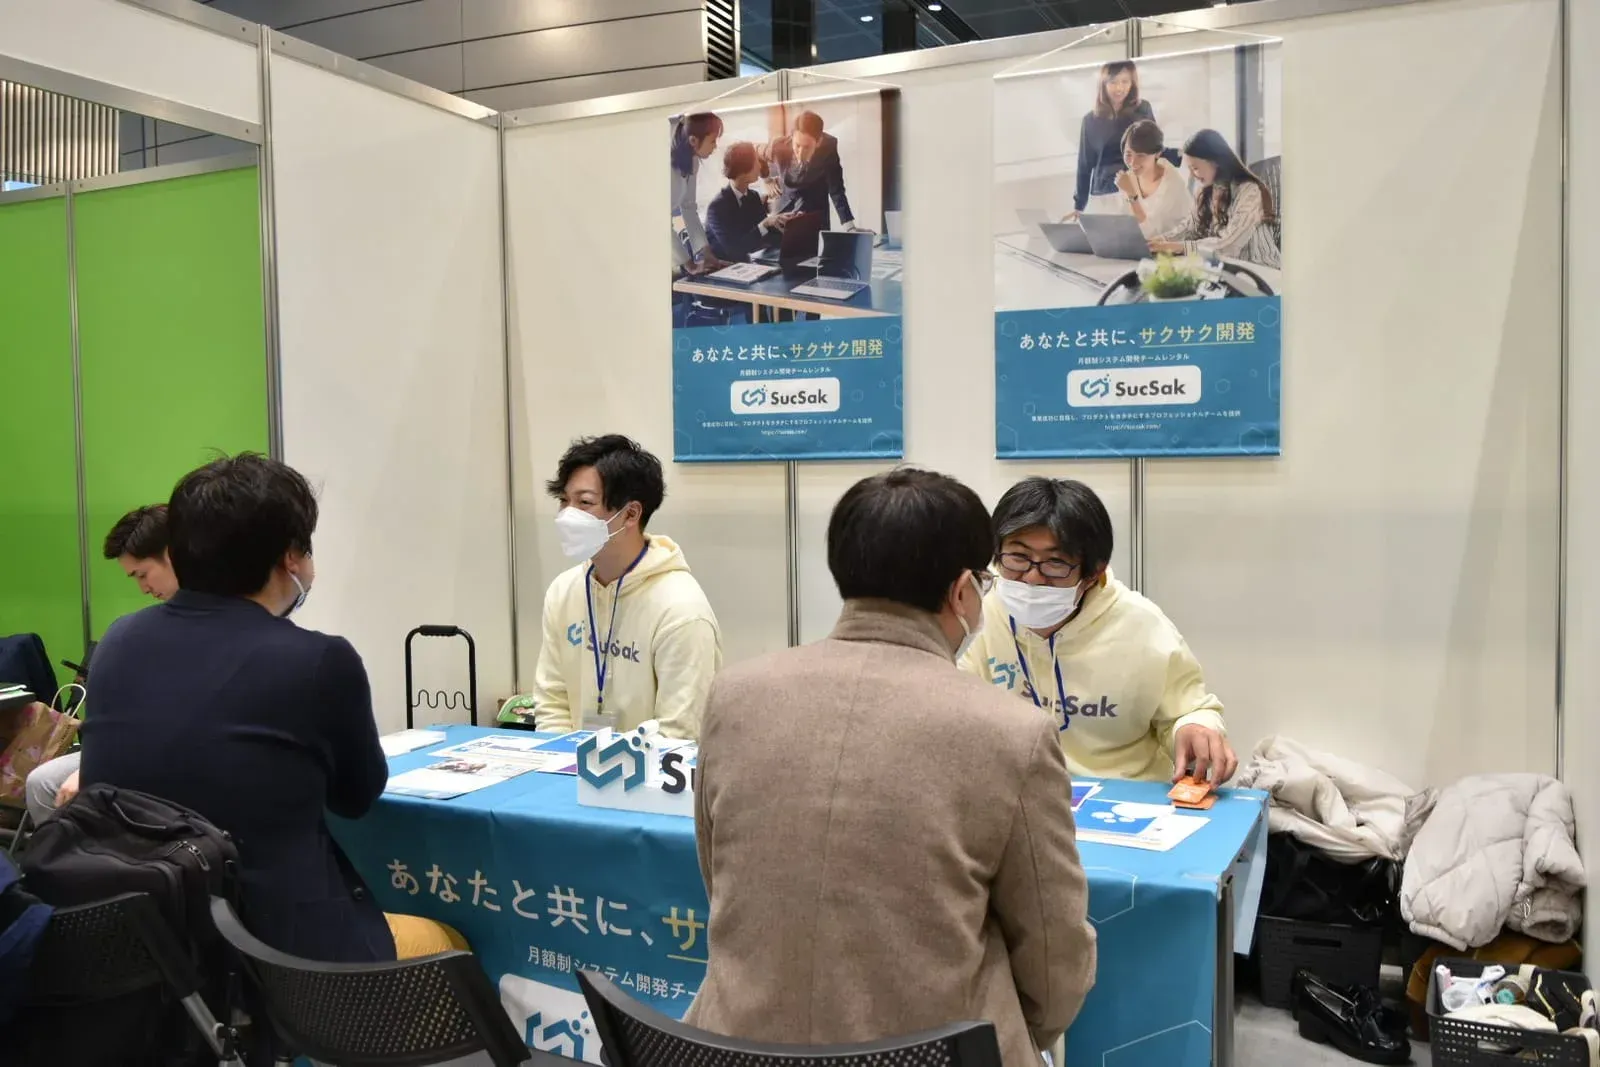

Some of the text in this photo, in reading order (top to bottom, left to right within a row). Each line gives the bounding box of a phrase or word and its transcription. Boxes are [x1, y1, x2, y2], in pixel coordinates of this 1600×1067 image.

[1019, 321, 1256, 350] あなたと共に、サクサク開発
[692, 339, 884, 363] あなたと共に、サクサク開発
[770, 389, 829, 406] SucSak
[1115, 379, 1187, 398] SucSak
